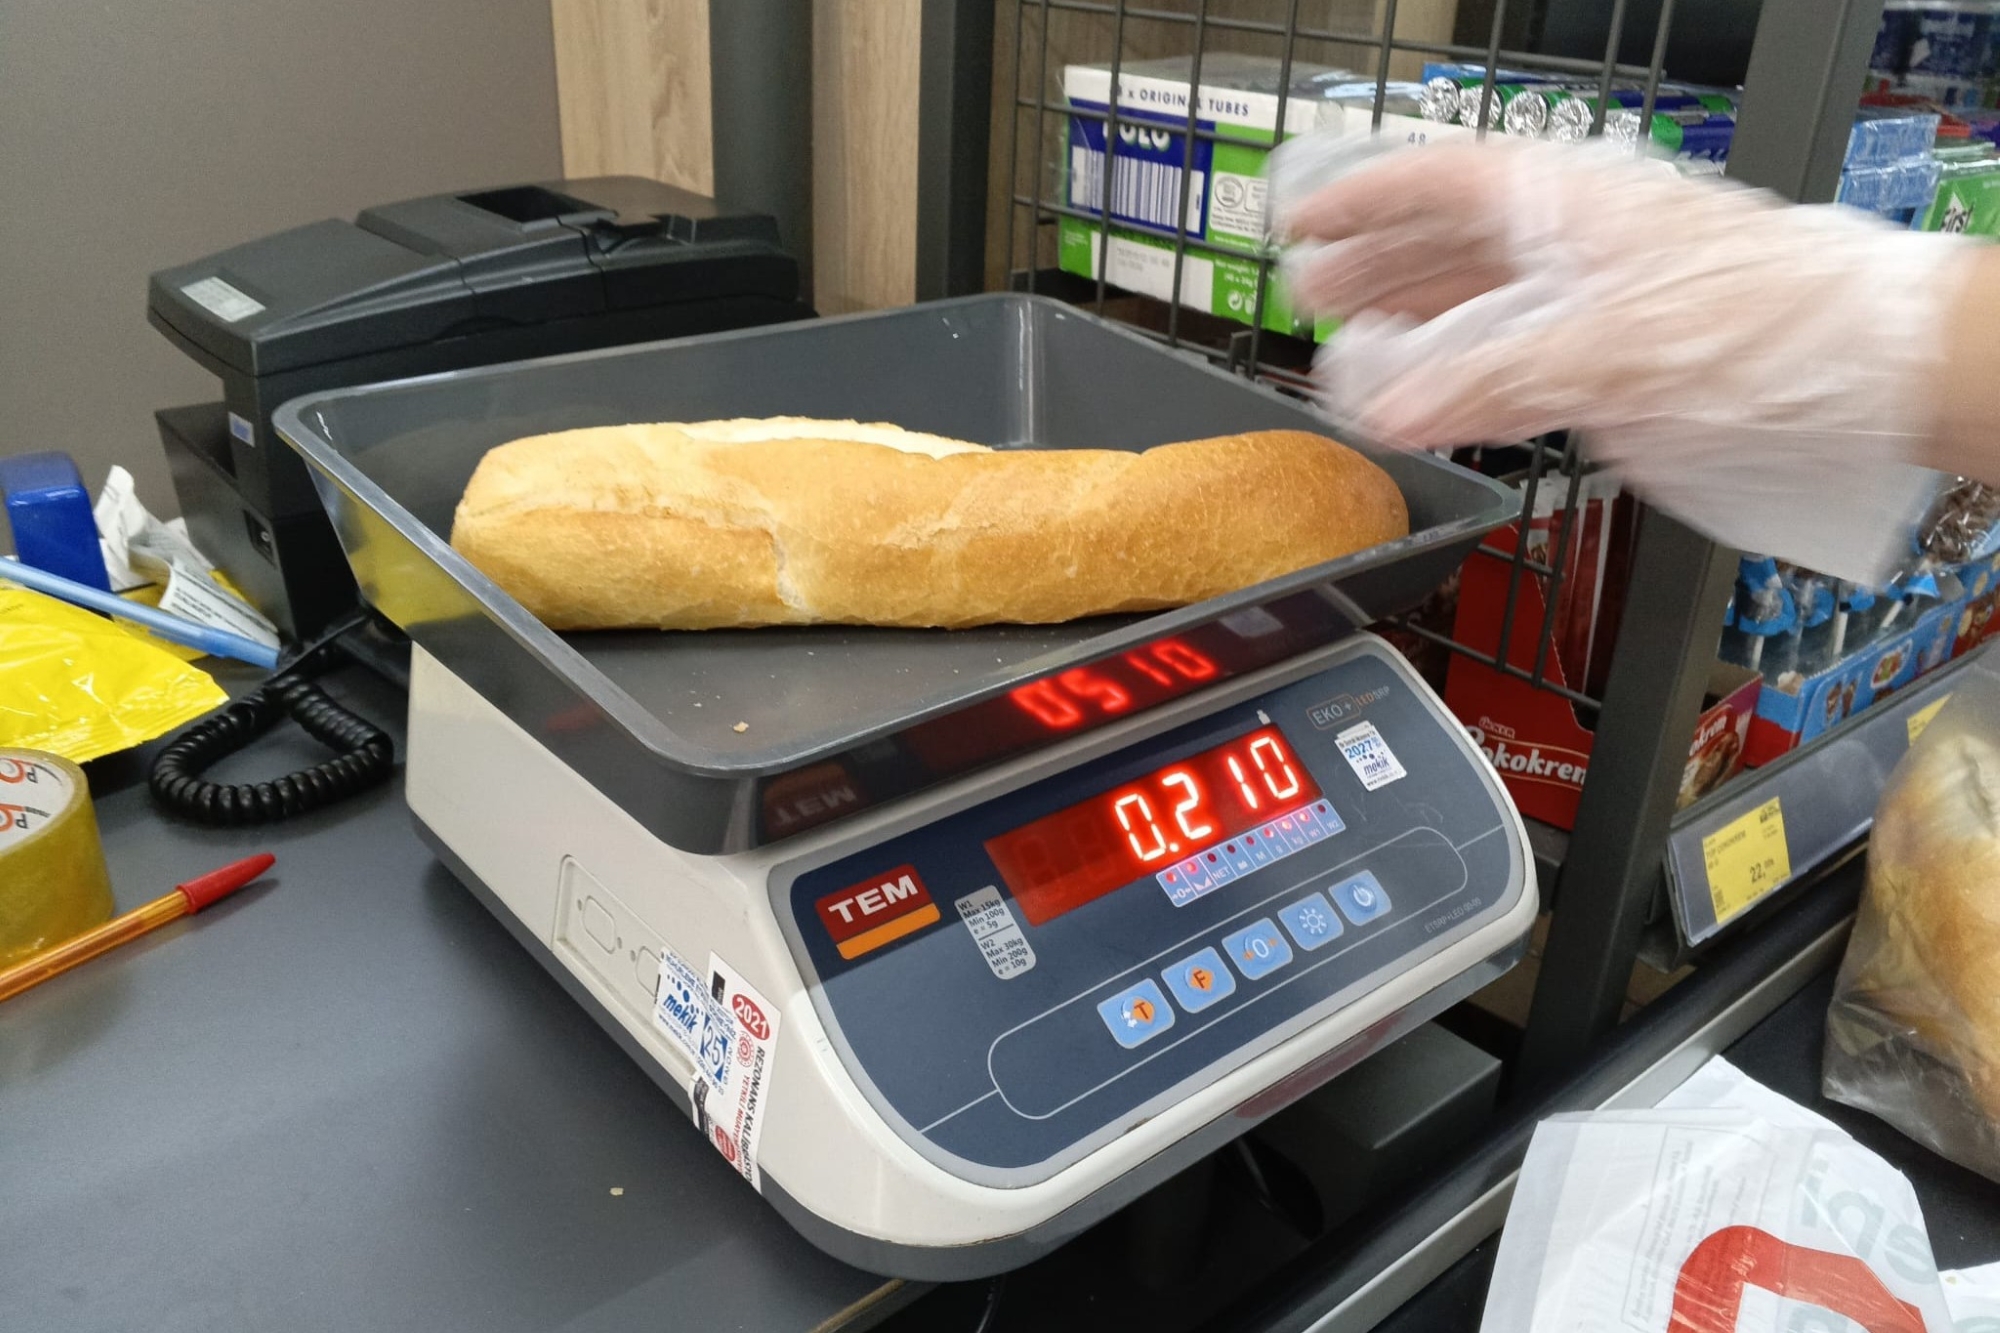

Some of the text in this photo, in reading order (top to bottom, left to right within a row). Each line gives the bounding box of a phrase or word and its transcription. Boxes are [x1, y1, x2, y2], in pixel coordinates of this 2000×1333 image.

[1139, 88, 1203, 111] ORIGINL
[1208, 98, 1250, 117] TUBES
[1311, 703, 1344, 725] EKO
[1344, 739, 1374, 760] 2027
[1212, 866, 1232, 881] NET
[827, 874, 919, 924] TEM
[957, 900, 974, 911] W1
[962, 898, 1001, 919] Max 15kg
[967, 907, 1005, 927] Min 100g
[980, 938, 996, 950] W2
[985, 937, 1024, 959] Max 30kg
[991, 946, 1028, 968] Min 200g
[1010, 958, 1027, 969] 10g
[1192, 969, 1206, 989] F
[662, 993, 698, 1034] mekik
[733, 996, 768, 1039] 2021
[1134, 1001, 1150, 1020] T
[747, 1046, 765, 1114] REZONANS
